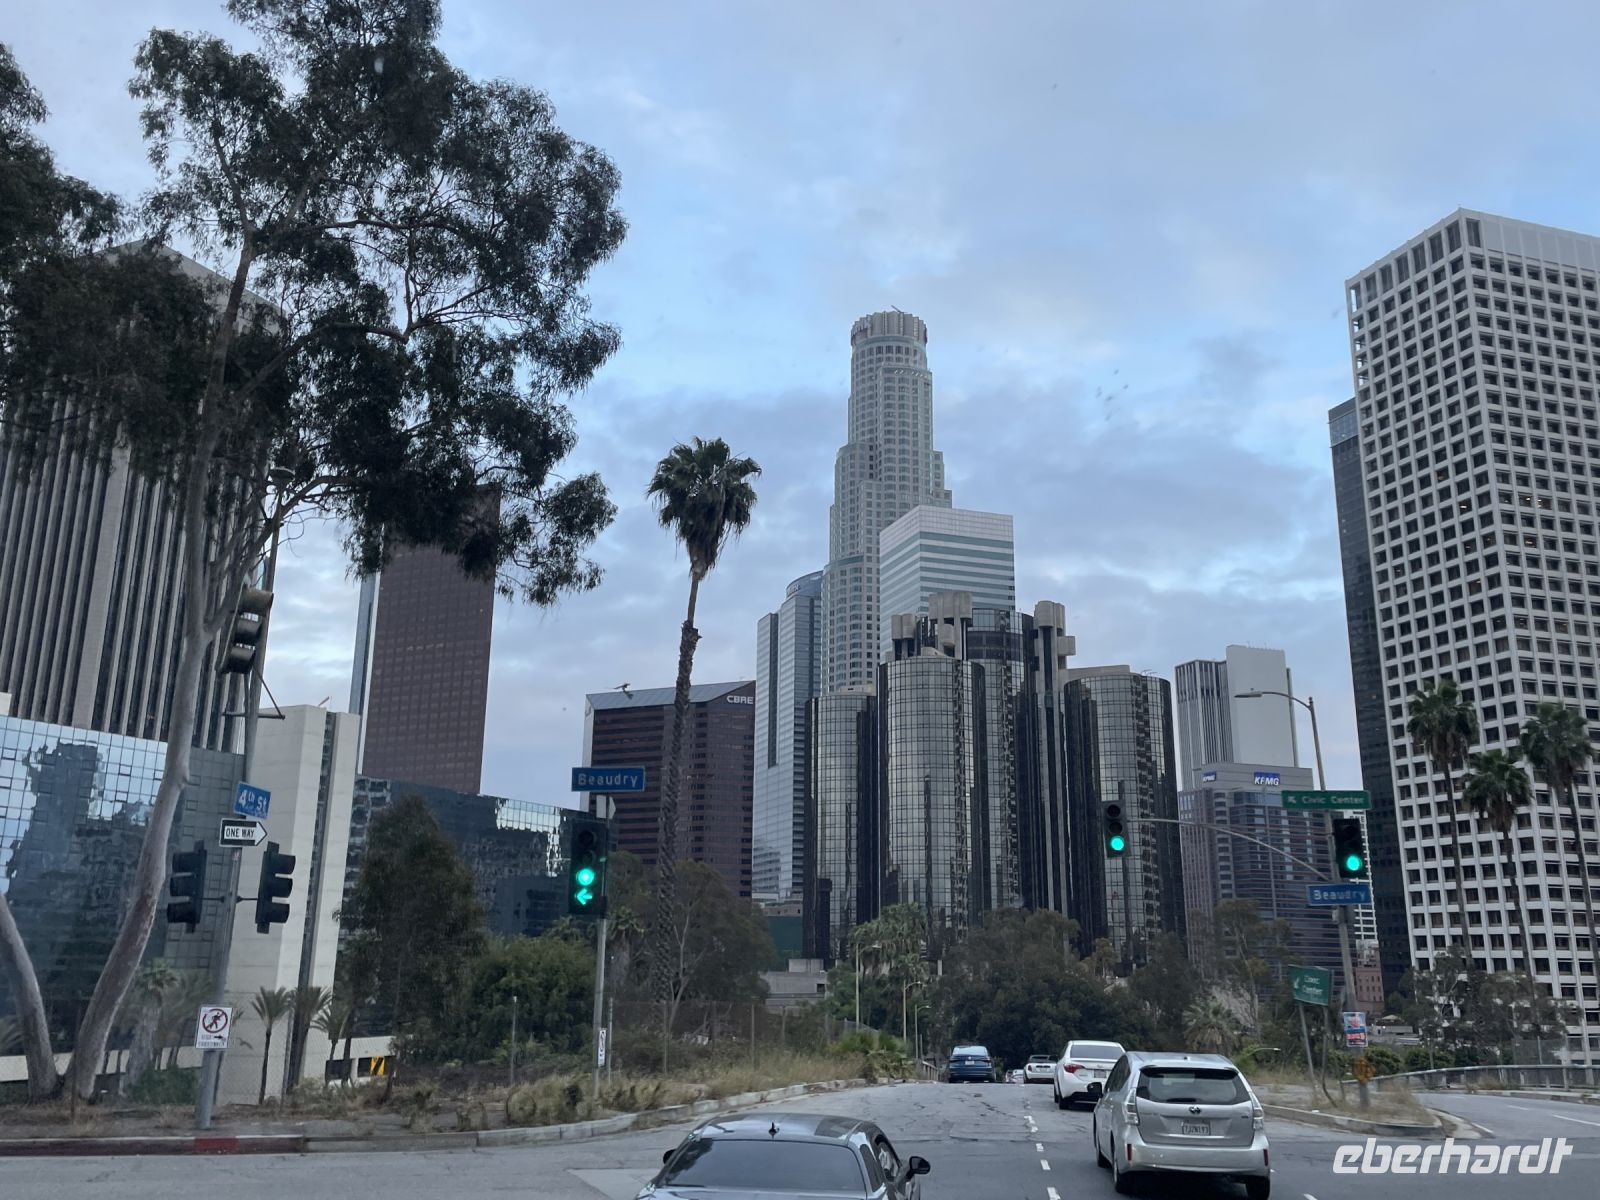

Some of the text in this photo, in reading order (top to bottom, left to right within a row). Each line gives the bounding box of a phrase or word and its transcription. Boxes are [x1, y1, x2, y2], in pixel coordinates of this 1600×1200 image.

[726, 695, 754, 705] CBRE
[577, 773, 638, 788] Beaudry
[1254, 776, 1279, 786] KPMG
[238, 789, 267, 812] 4th St
[1302, 796, 1365, 804] Civic Center
[225, 828, 255, 838] ONE WAY
[1313, 889, 1366, 901] Beaudry
